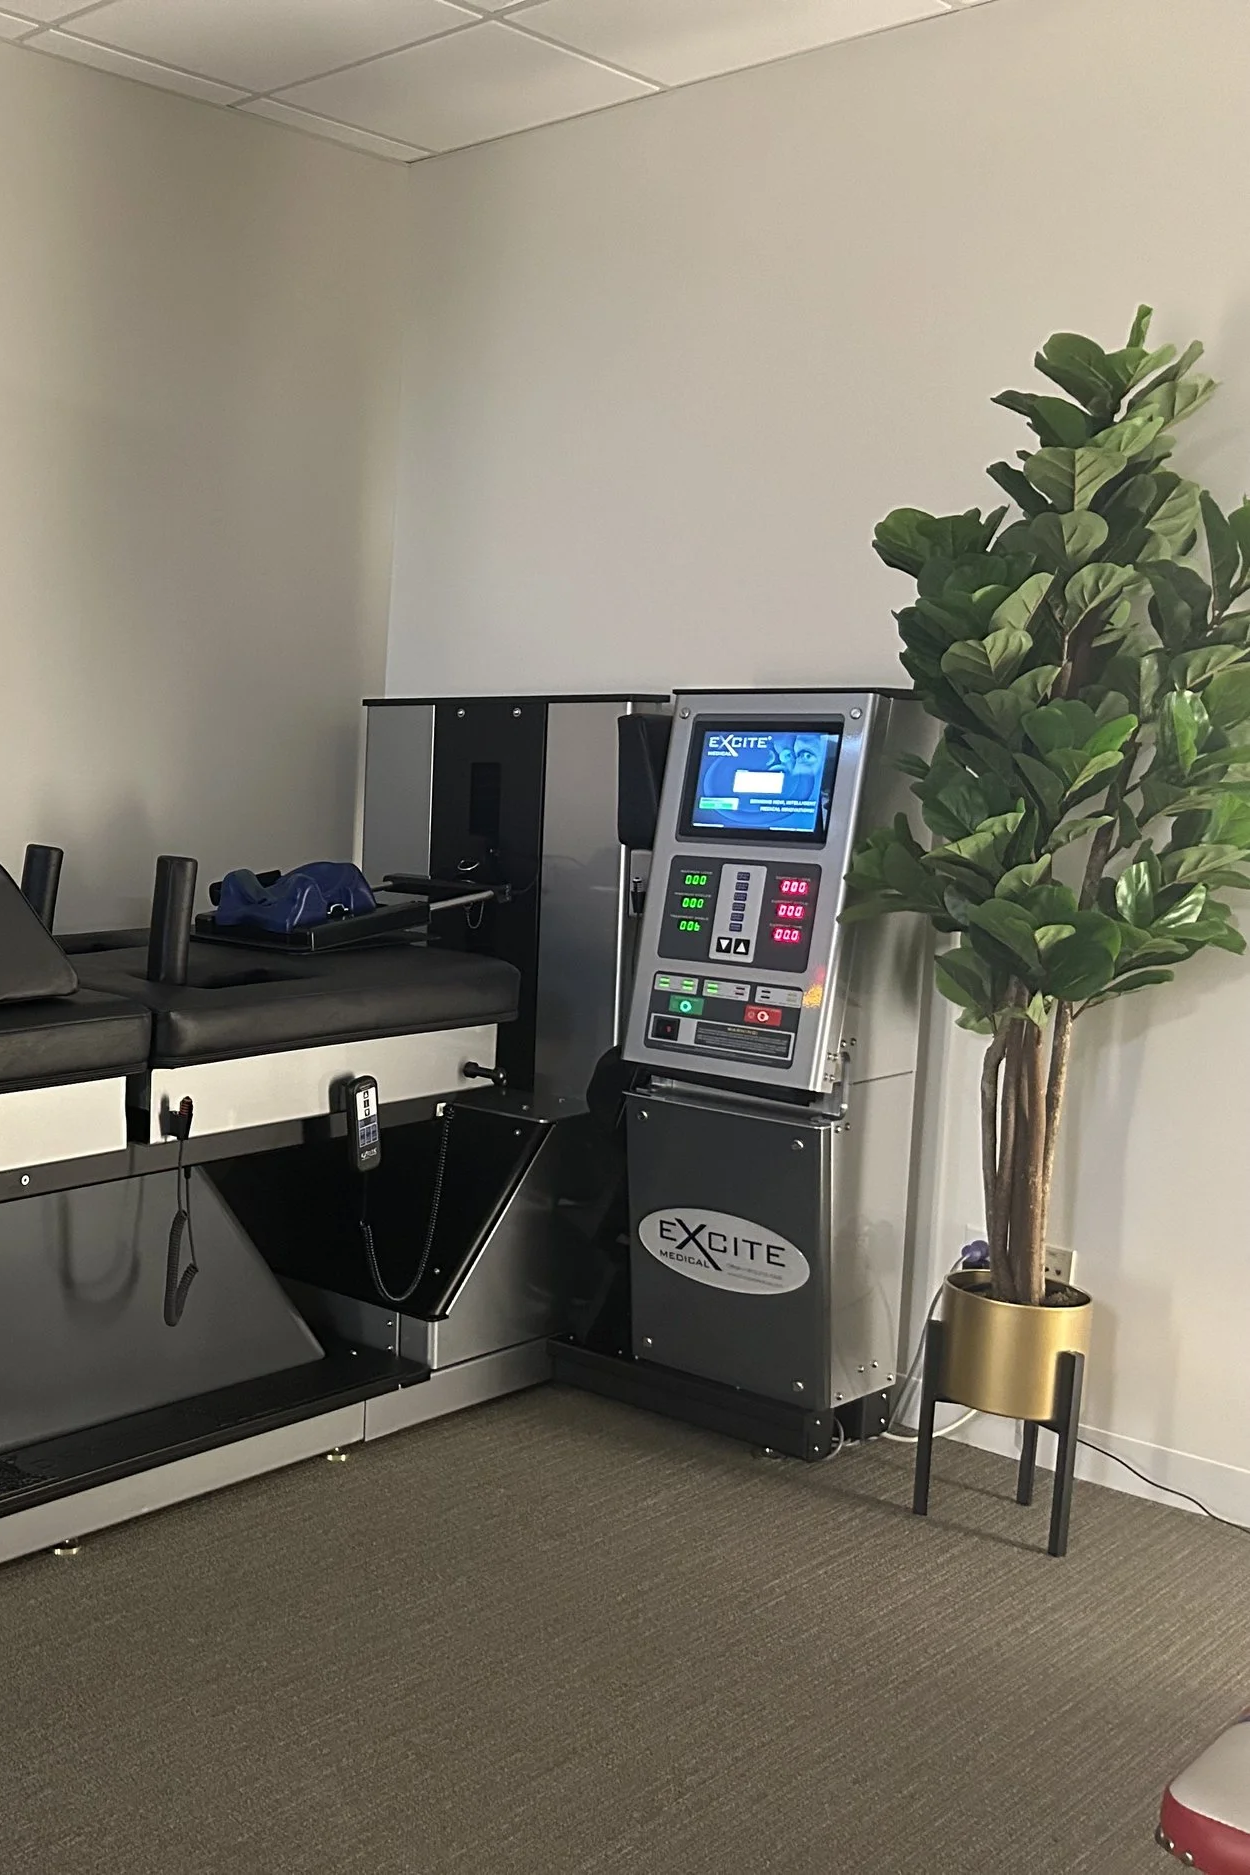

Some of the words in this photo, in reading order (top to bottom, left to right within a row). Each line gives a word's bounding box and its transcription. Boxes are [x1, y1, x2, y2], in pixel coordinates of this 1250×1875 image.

[709, 734, 767, 757] EXCITE
[685, 874, 707, 885] 000
[781, 880, 807, 893] 000
[682, 897, 704, 909] 000
[778, 904, 804, 917] 000
[659, 1217, 786, 1272] EXCITE
[659, 1249, 710, 1269] MEDICAL
